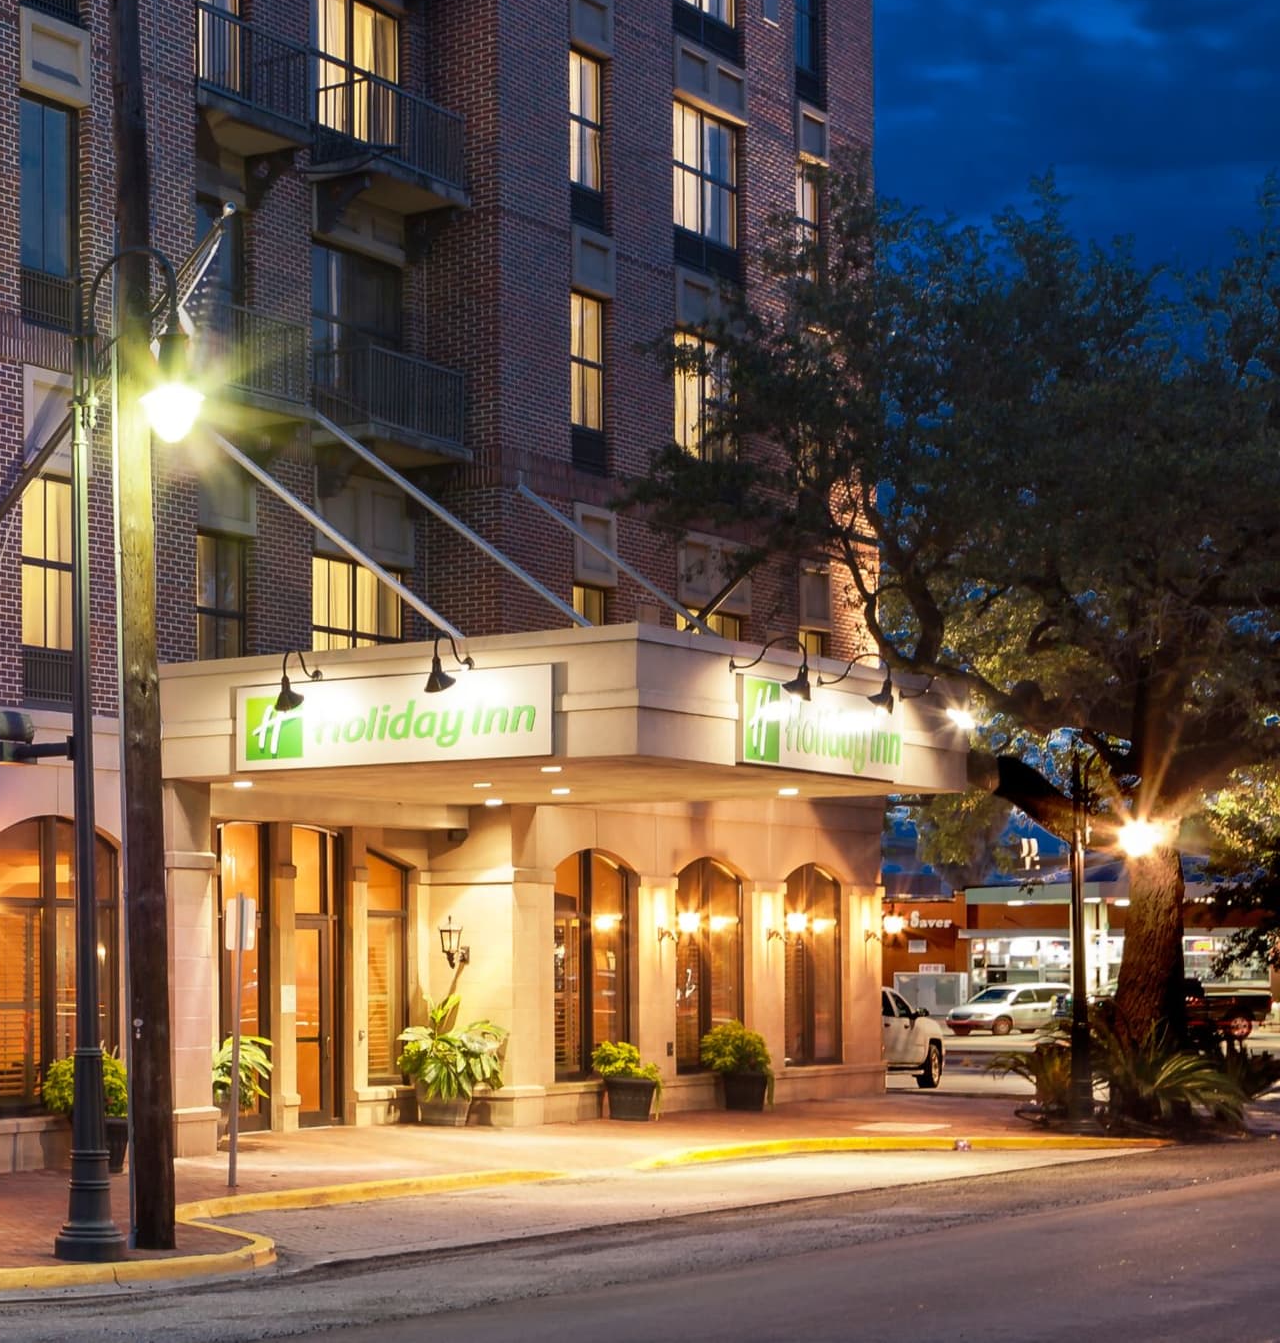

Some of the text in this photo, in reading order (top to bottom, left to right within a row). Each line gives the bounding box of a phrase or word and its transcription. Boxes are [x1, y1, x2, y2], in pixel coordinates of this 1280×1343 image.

[471, 702, 537, 736] Inn
[870, 722, 903, 767] Inn
[910, 910, 953, 929] Saver
